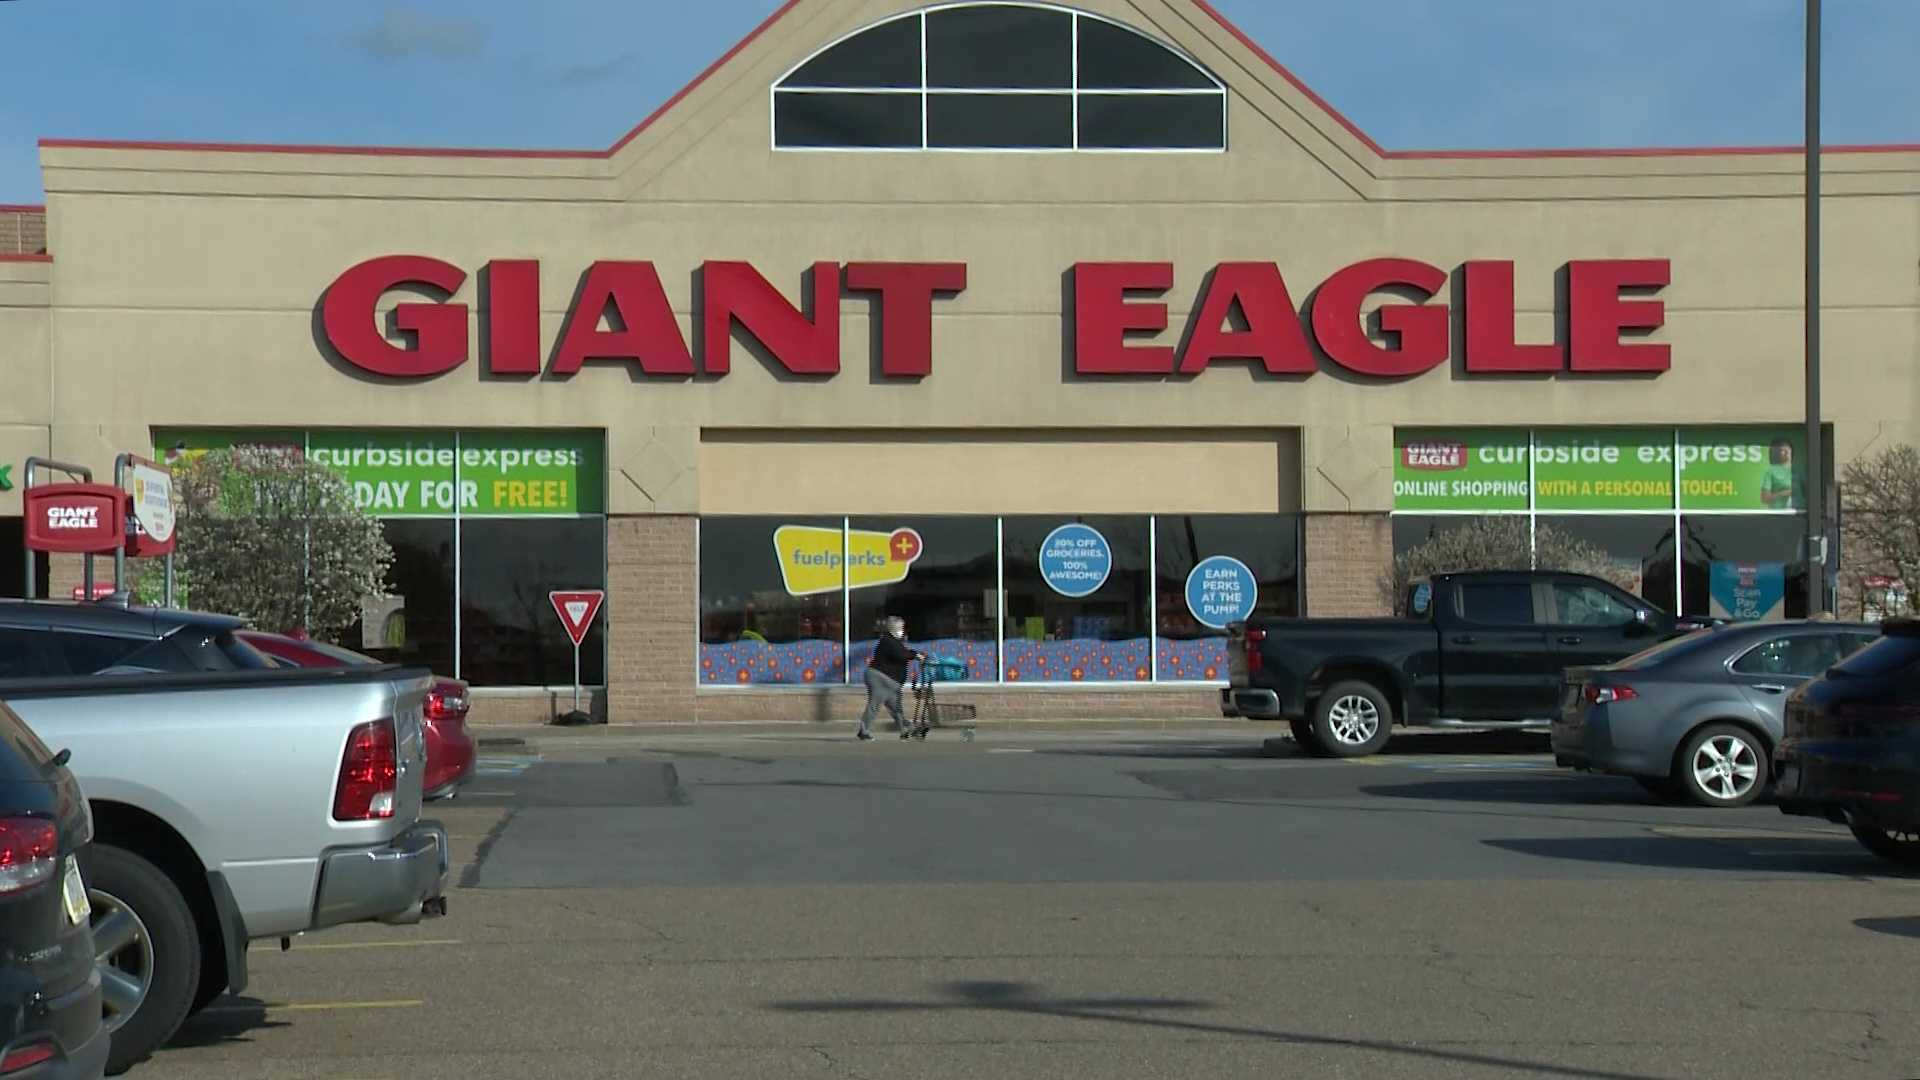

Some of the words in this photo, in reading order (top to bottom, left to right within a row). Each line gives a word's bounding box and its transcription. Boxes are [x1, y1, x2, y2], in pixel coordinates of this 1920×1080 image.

[320, 254, 967, 379] GIANT
[1072, 257, 1671, 379] EAGLE
[1407, 443, 1462, 454] GIANT
[312, 442, 454, 467] curbside
[463, 447, 584, 474] express
[1408, 454, 1461, 466] EAGLE
[1478, 440, 1619, 464] curbside
[1637, 445, 1762, 470] express
[353, 480, 410, 509] DAY
[420, 480, 479, 508] FOR
[493, 480, 568, 508] FREE!
[1393, 480, 1449, 496] ONLINE
[1452, 480, 1529, 497] SHOPPING
[1538, 480, 1577, 496] WITH
[1582, 480, 1591, 496] A
[1595, 480, 1673, 496] PERSONAL
[1680, 480, 1738, 496] TOUCH.
[48, 506, 99, 518] GIANT
[49, 518, 98, 528] EAGLE
[1076, 538, 1097, 548] OFF
[793, 549, 886, 569] fuelperks
[1063, 561, 1088, 570] 100%
[1205, 569, 1238, 579] EARN
[1203, 581, 1240, 591] PERKS
[1202, 592, 1216, 602] AT
[1220, 592, 1242, 602] THE
